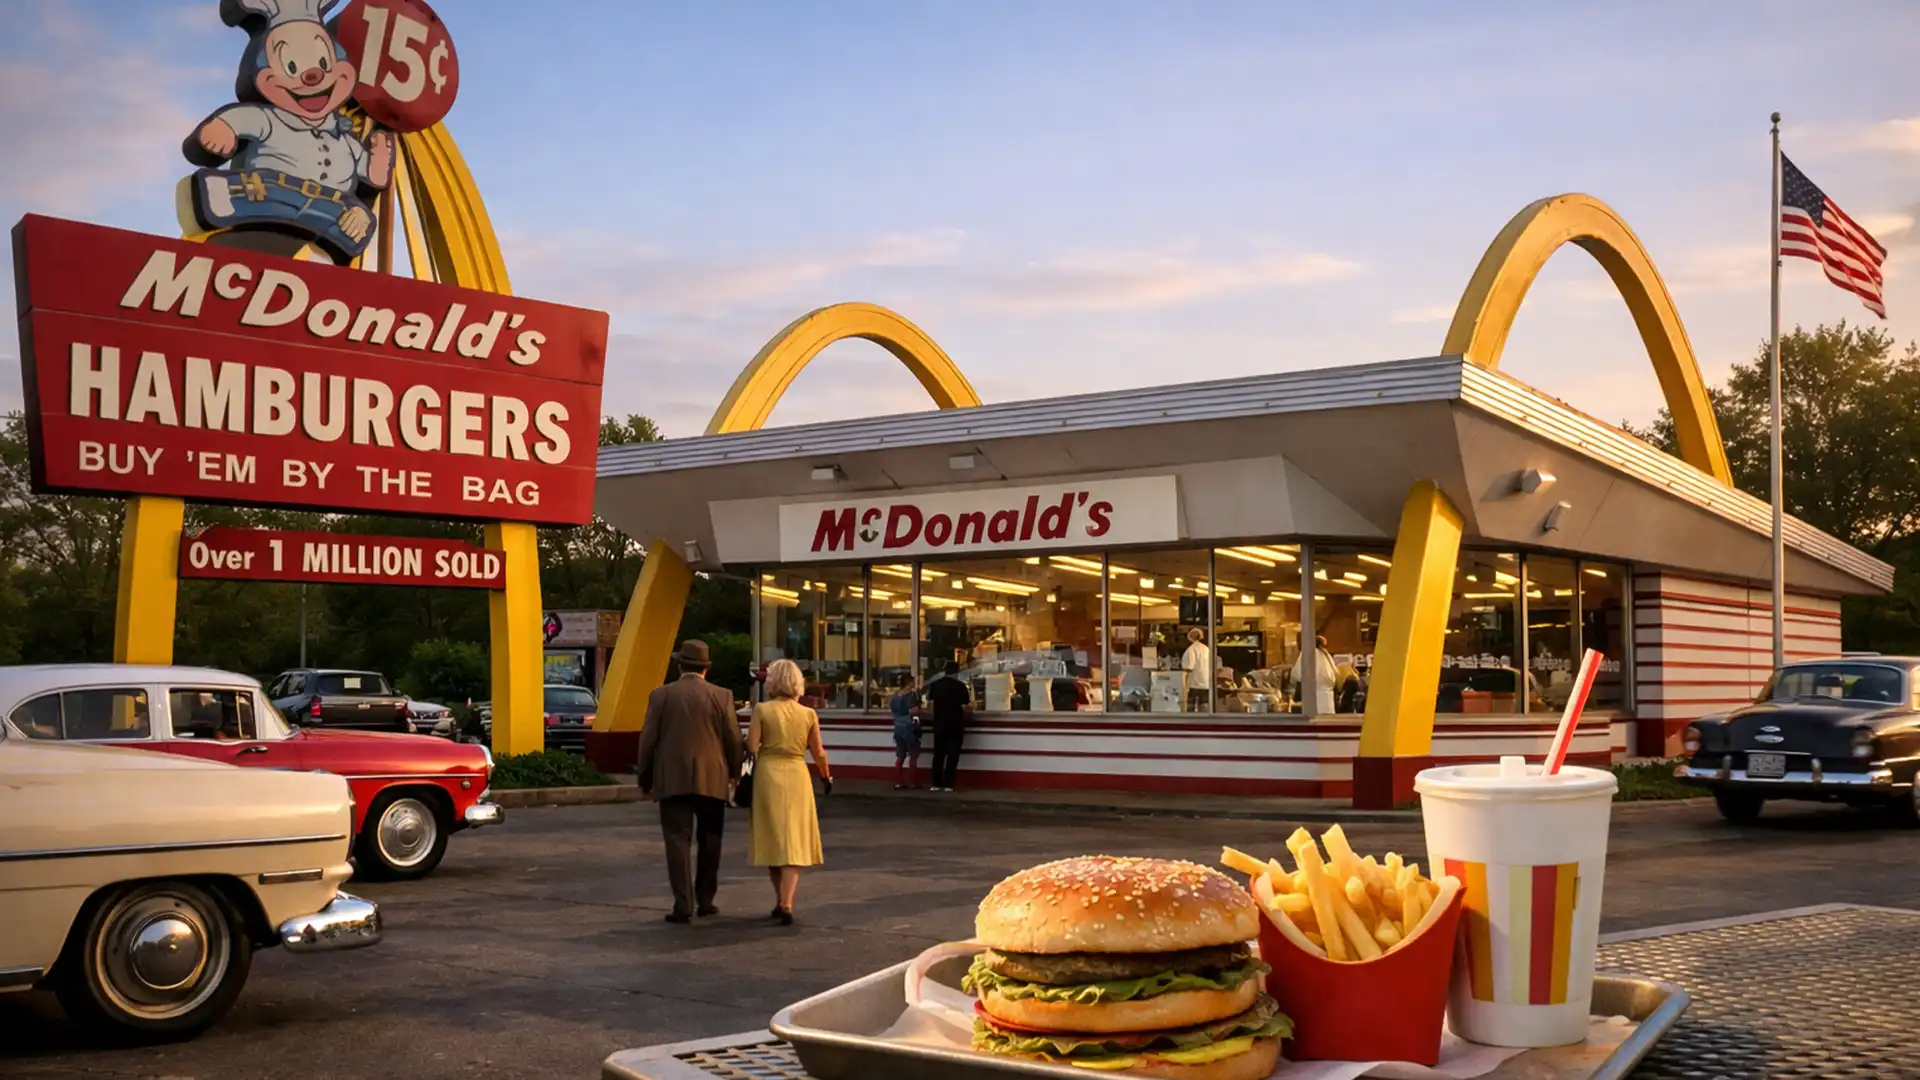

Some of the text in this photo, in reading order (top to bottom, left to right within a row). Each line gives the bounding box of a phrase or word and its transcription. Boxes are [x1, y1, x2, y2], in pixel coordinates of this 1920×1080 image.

[359, 4, 449, 102] 15¢
[120, 249, 546, 365] McDonald's
[70, 342, 571, 465] HAMBURGERS
[79, 442, 540, 506] BUY 'EM BY THE BAG
[189, 539, 501, 580] Over 1 MILLION SOLD
[811, 491, 1114, 552] McDonald's
